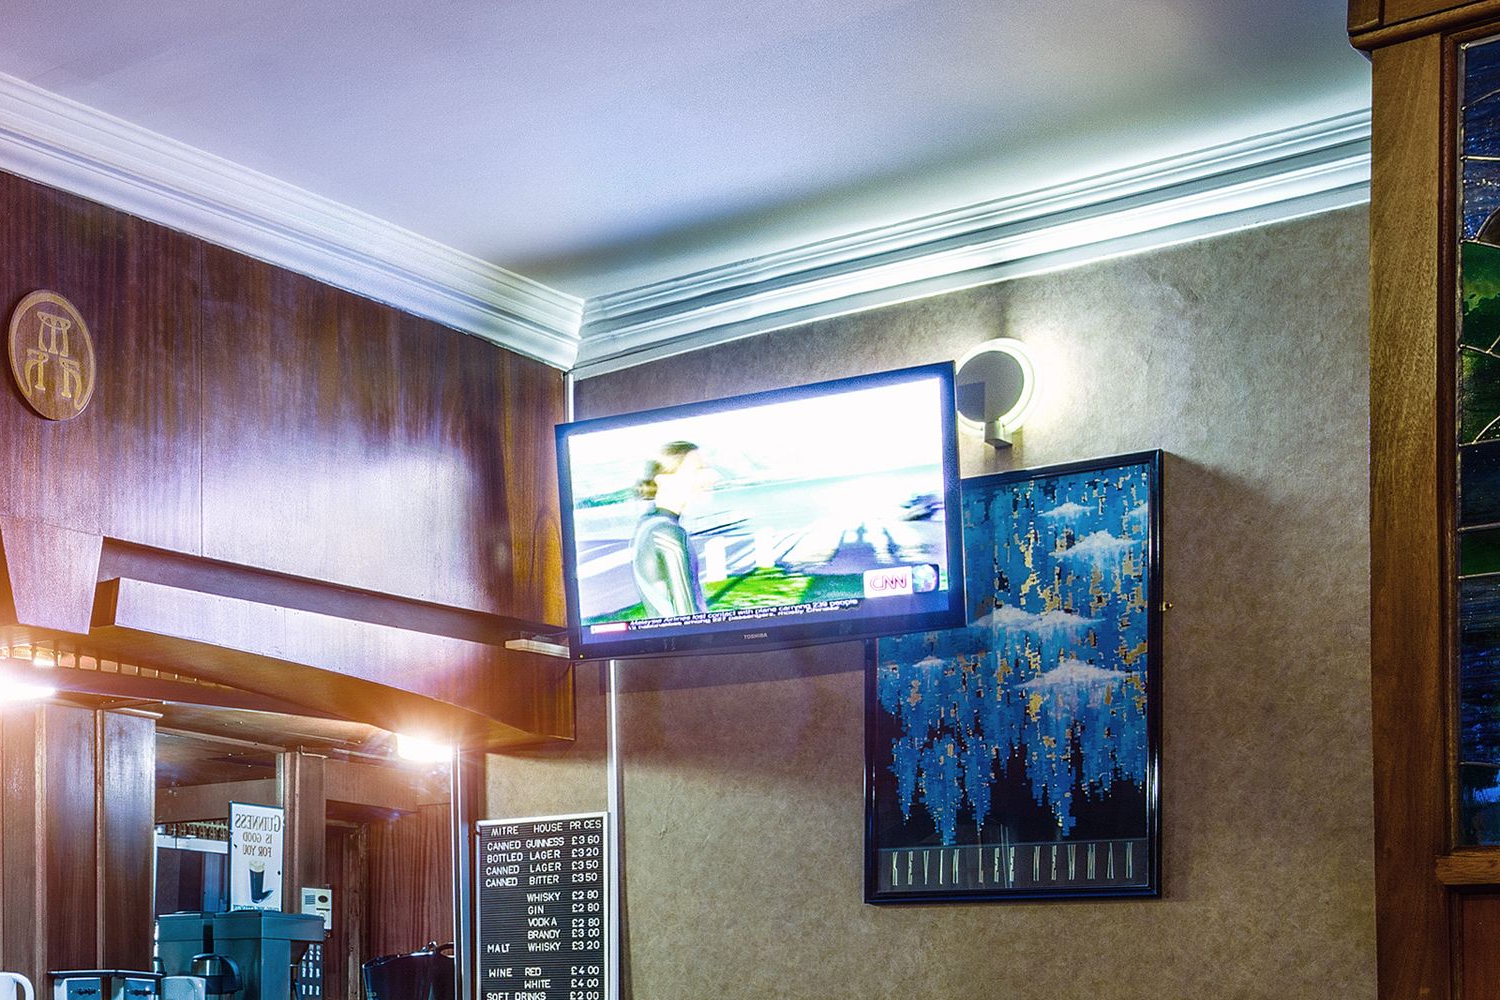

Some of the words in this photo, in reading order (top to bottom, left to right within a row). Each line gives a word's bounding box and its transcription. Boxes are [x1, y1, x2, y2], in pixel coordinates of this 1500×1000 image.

[870, 574, 907, 591] CNN
[491, 826, 519, 837] MITRE
[533, 822, 563, 834] HOUSE
[487, 840, 521, 852] CANNED
[526, 837, 564, 849] GUINNESS
[486, 852, 523, 864] BOTTLED
[529, 850, 560, 860] LAGER
[892, 848, 960, 886] KEVIN
[978, 846, 1015, 884] LEE
[1033, 841, 1133, 882] NEWMAN
[486, 865, 520, 876] CANNED
[529, 862, 562, 874] LAGER
[486, 877, 518, 888] CANNED
[529, 874, 560, 886] BITTER
[526, 892, 561, 902] WHISKY
[528, 905, 544, 915] GIN
[528, 917, 558, 927] VODKA
[528, 930, 560, 940] BRANDY
[487, 943, 510, 954] MALT
[528, 942, 561, 952] WHISKY
[488, 968, 512, 978] WINE
[524, 967, 542, 976] RED
[524, 979, 551, 989] WHITE
